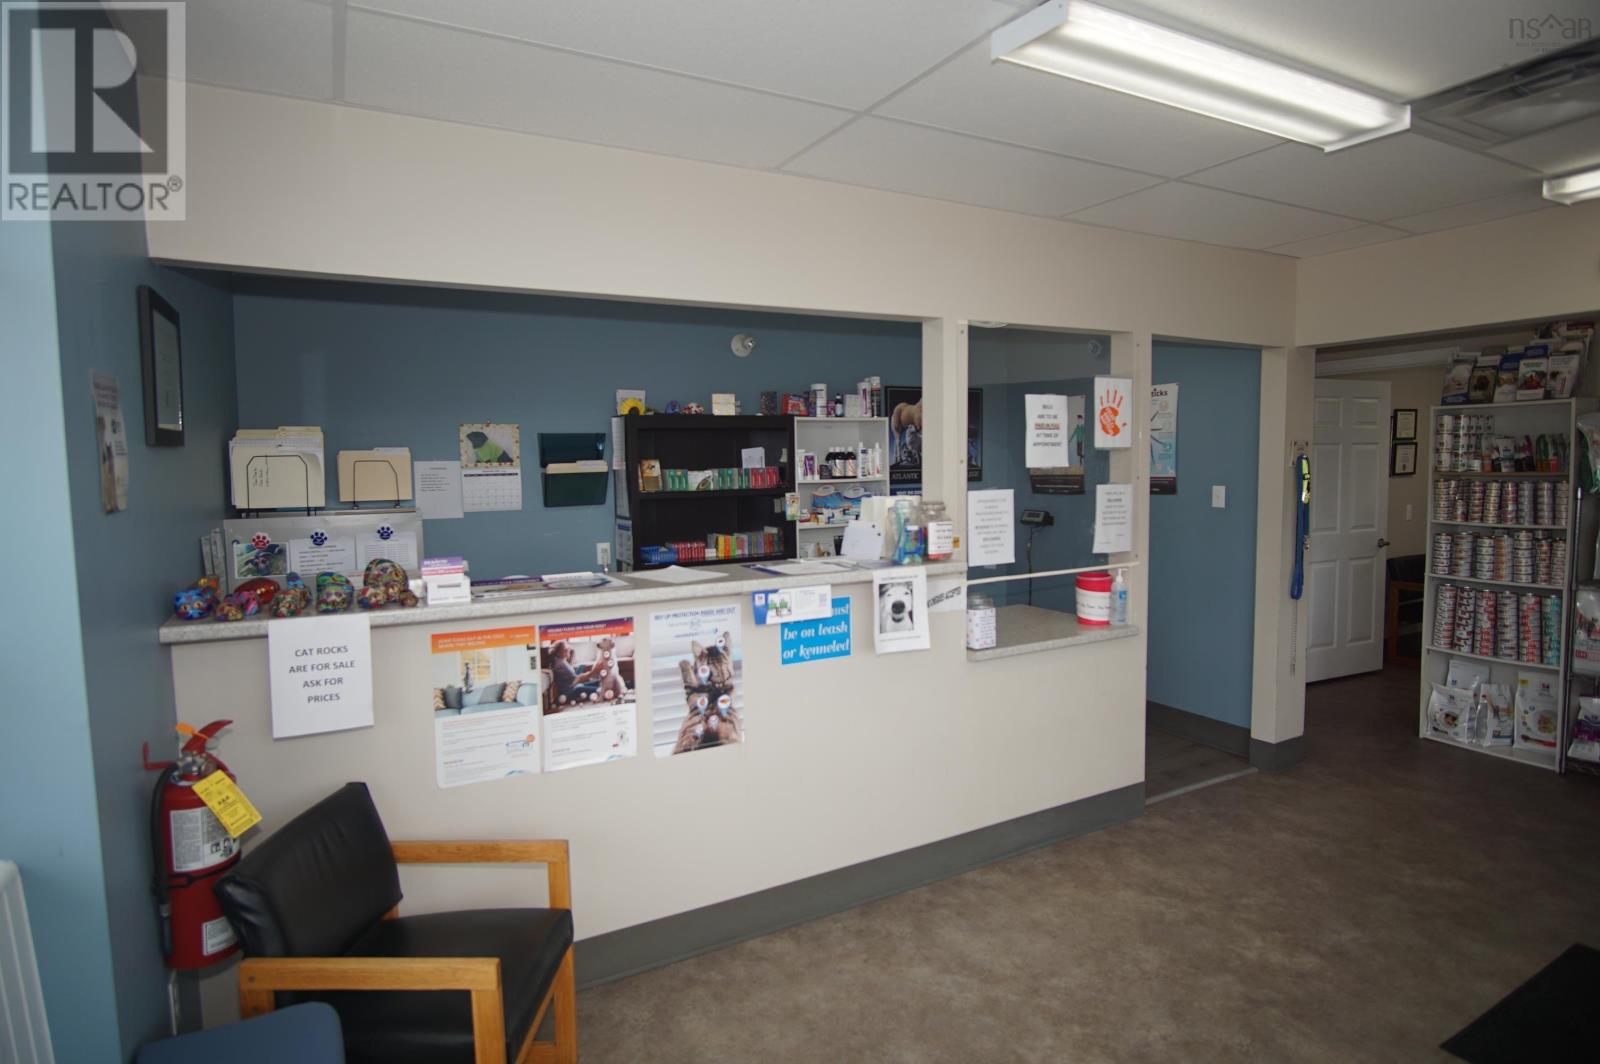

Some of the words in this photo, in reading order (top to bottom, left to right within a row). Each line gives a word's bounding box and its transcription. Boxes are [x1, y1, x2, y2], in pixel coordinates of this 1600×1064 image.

[783, 627, 798, 641] be
[800, 627, 815, 638] on
[818, 620, 848, 637] leash
[294, 648, 314, 657] CAT
[316, 645, 348, 655] ROCKS
[783, 648, 797, 660] or
[800, 637, 850, 660] kenneled
[288, 664, 308, 674] ARE
[311, 662, 330, 672] FOR
[332, 660, 355, 670] SALE
[302, 680, 321, 688] ASK
[324, 677, 343, 686] FOR
[307, 693, 340, 703] PRICES
